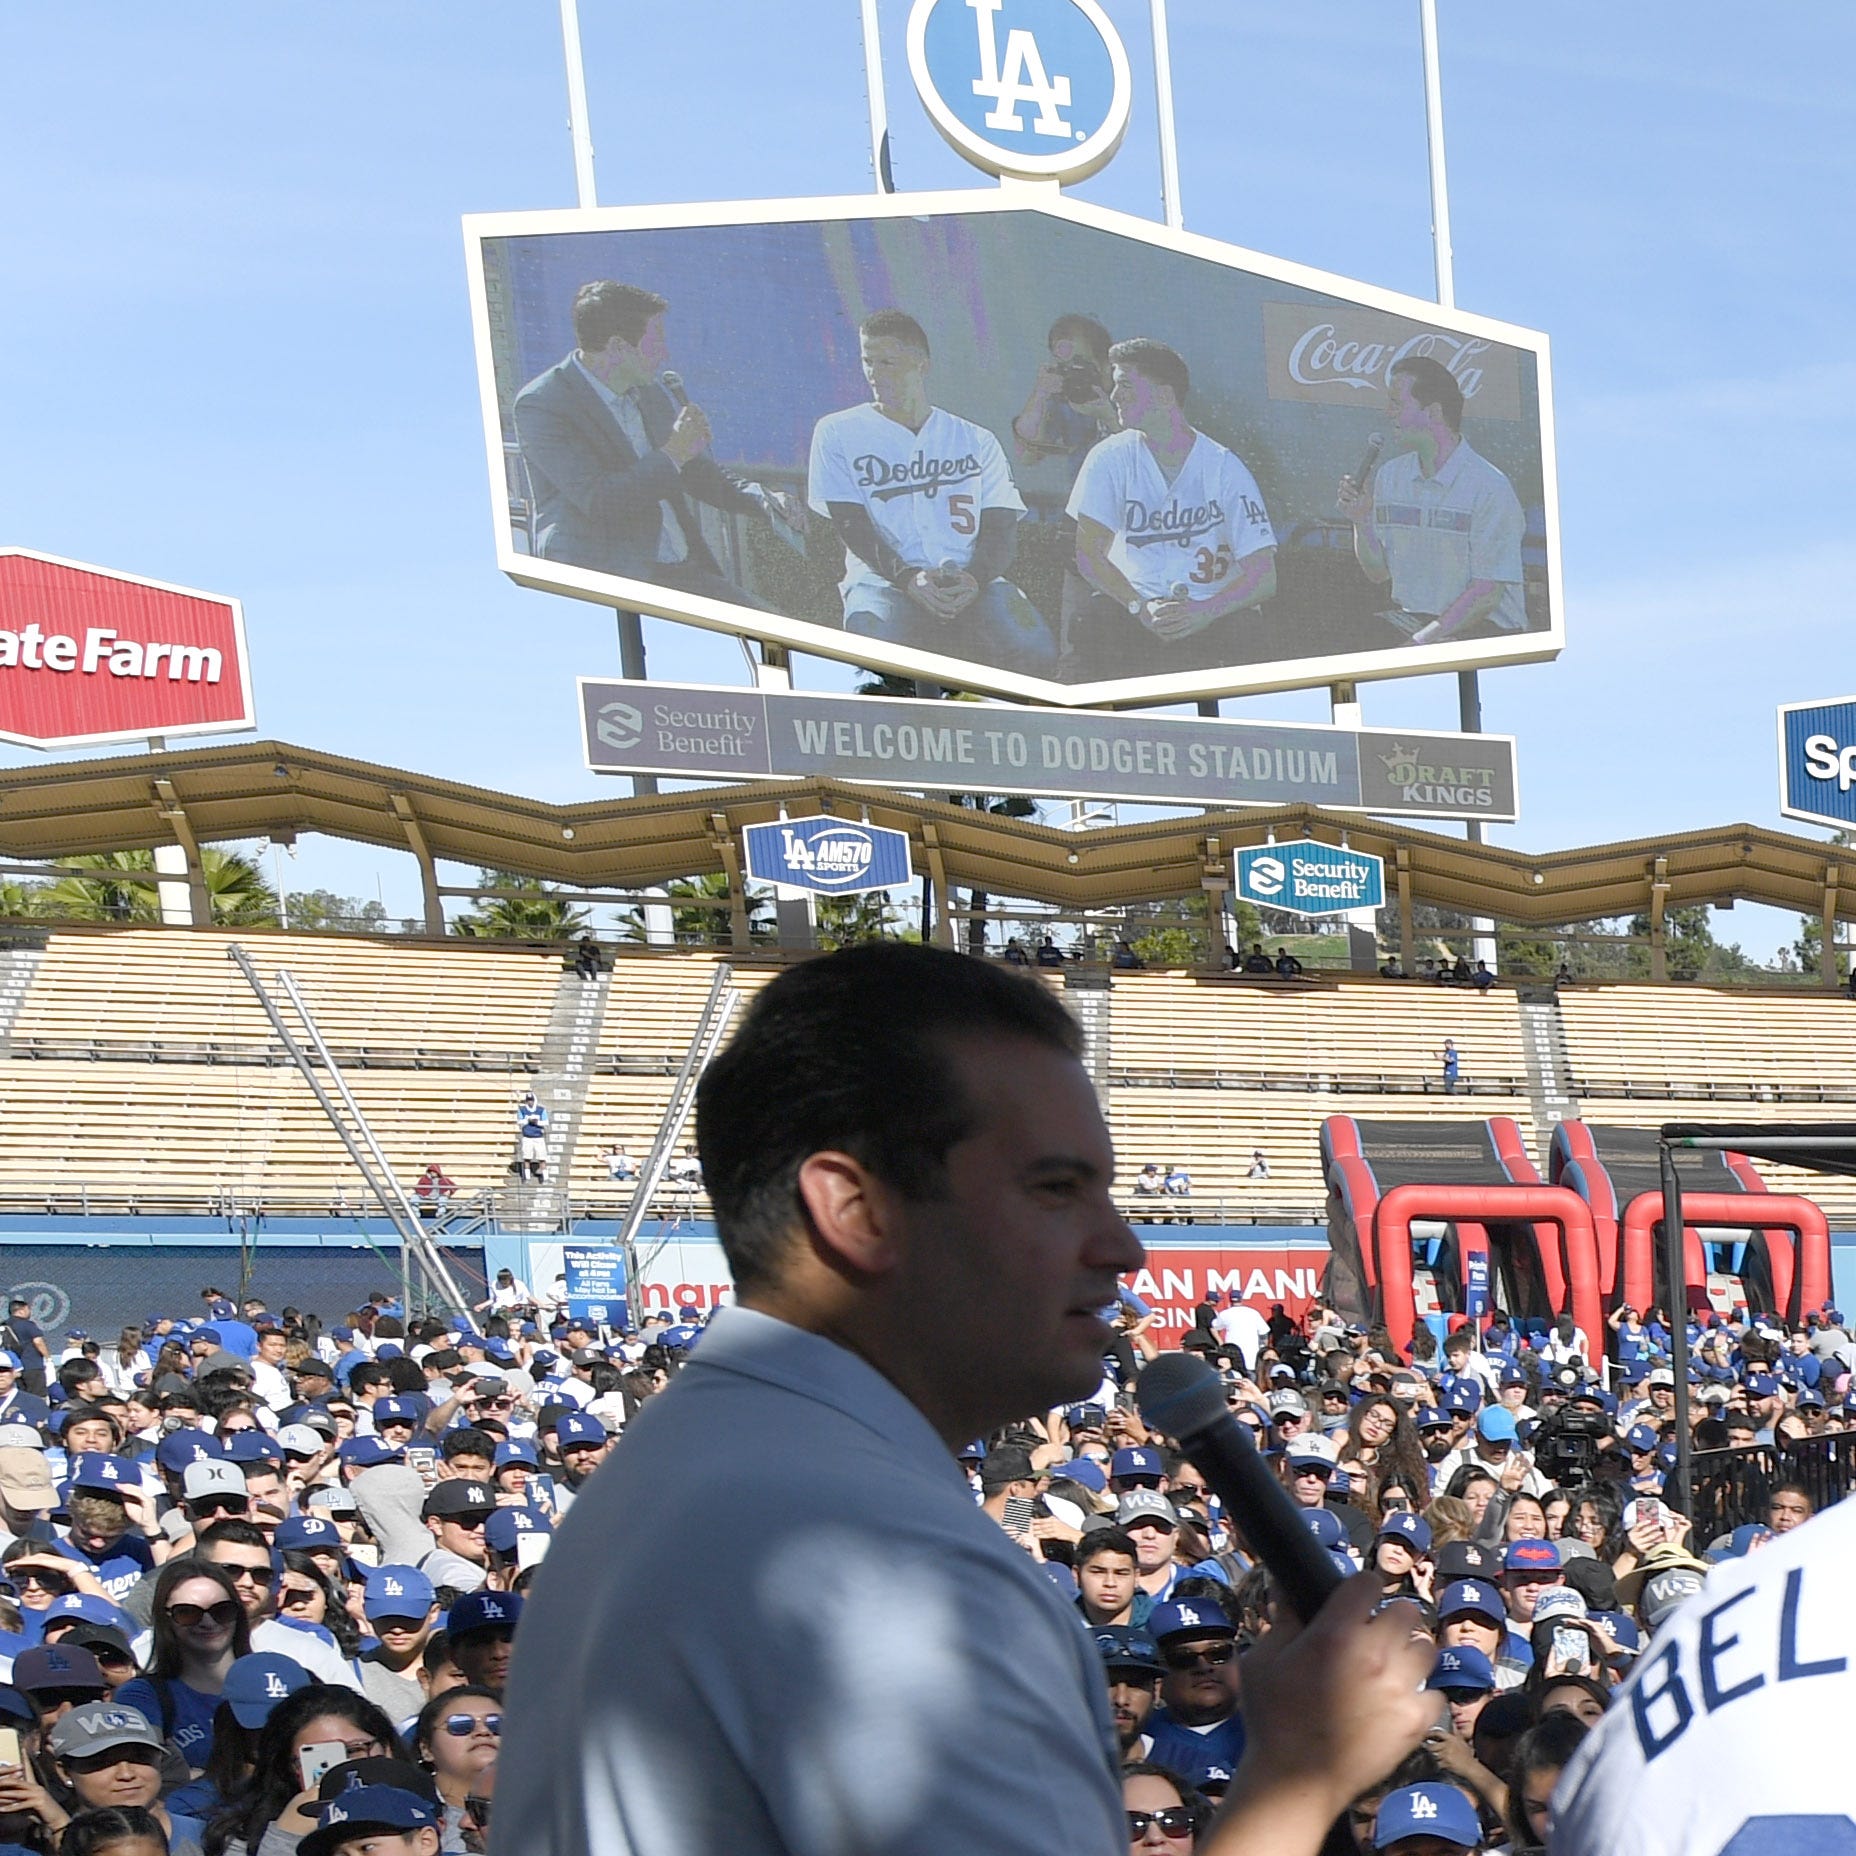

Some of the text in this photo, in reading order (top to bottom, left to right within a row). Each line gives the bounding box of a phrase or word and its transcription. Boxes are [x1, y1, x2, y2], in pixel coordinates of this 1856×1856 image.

[965, 0, 1072, 138] LA
[1289, 324, 1491, 400] Coca-Cla
[853, 451, 982, 499] Dodgers
[948, 494, 975, 534] 5
[1239, 494, 1268, 525] LA
[1125, 498, 1225, 548] Dodges
[1189, 545, 1231, 584] 35
[83, 627, 222, 683] Farm
[654, 703, 757, 736] Security
[656, 730, 748, 756] Benefit
[793, 718, 1338, 785] WELCOME TO DODGER STADIUM
[1387, 762, 1496, 787] DRAFT
[1402, 785, 1493, 807] KINGS
[781, 829, 873, 870] LA AM570
[816, 862, 860, 872] SPORTS
[1291, 858, 1370, 883] Security
[1294, 877, 1361, 899] Benefit
[565, 1251, 622, 1262] This Activity
[570, 1260, 590, 1269] Will
[1207, 1269, 1321, 1300] MANU
[569, 1418, 584, 1433] LA
[193, 1444, 208, 1459] LA
[1131, 1451, 1147, 1466] LA
[102, 1461, 118, 1479] LA
[467, 1487, 485, 1504] NY
[531, 1480, 550, 1502] LA
[302, 1518, 325, 1534] D
[512, 1511, 534, 1529] LA
[1402, 1515, 1417, 1531] LA
[384, 1576, 404, 1596] LA
[1462, 1584, 1481, 1602] LA
[481, 1596, 505, 1618] LA
[1176, 1602, 1200, 1626] LA
[1601, 1616, 1617, 1636] LA
[1440, 1652, 1461, 1671] LA
[264, 1672, 290, 1697] LA
[327, 1802, 348, 1825] LA
[1410, 1792, 1438, 1819] LA
